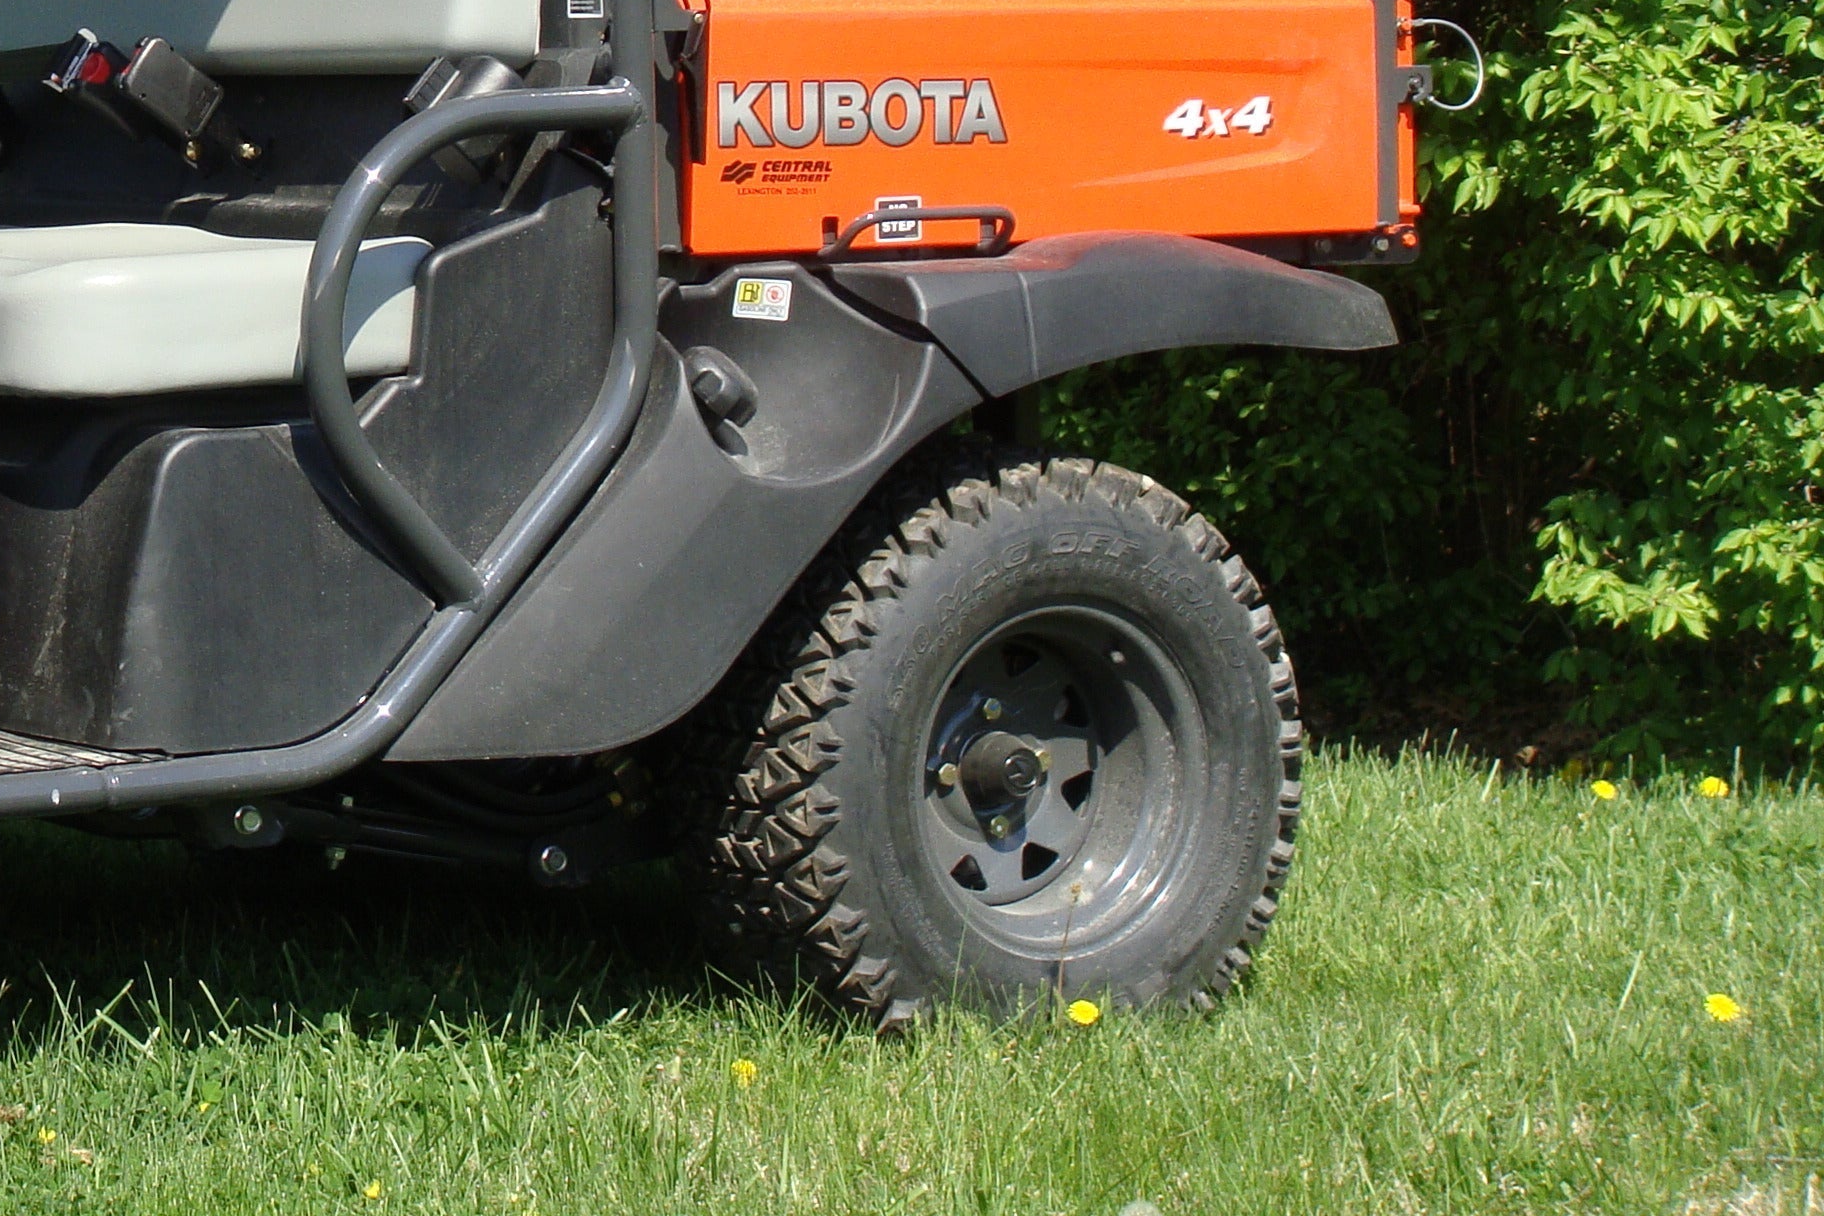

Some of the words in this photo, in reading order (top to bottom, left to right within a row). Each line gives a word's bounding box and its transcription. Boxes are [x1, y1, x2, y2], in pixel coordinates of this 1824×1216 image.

[717, 77, 1007, 149] KUBOTA
[1162, 96, 1273, 138] 4x4
[762, 160, 832, 172] CENTRAL
[761, 174, 830, 183] EQUIPMENT
[881, 220, 916, 233] STEP
[1048, 530, 1141, 557] OFF
